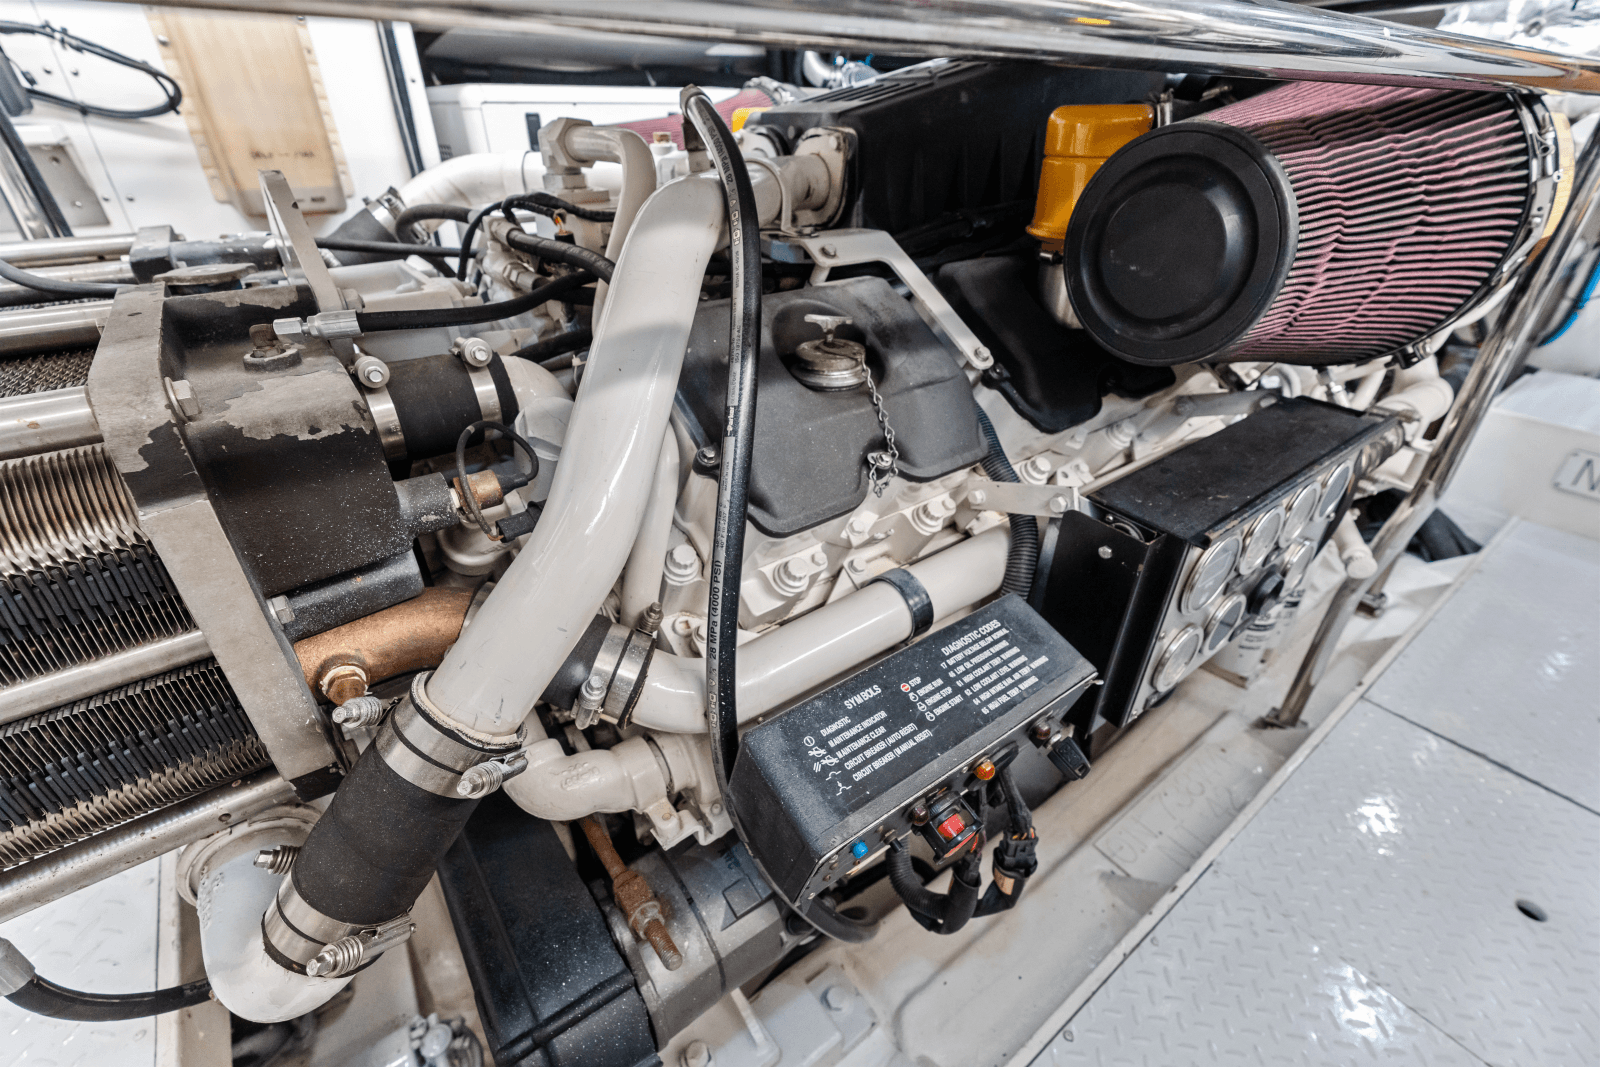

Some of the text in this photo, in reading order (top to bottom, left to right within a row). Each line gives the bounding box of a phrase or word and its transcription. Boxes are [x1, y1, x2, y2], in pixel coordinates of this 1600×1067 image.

[721, 156, 730, 172] MPa
[725, 174, 734, 184] 28
[713, 560, 722, 583] PSI)
[710, 586, 720, 616] (4000
[710, 620, 718, 644] MPa
[941, 620, 1001, 656] DIAGNOSTIC CODES
[946, 652, 965, 666] BATTERY
[963, 643, 981, 656] VOLTAGE
[979, 636, 994, 647] BELOW
[991, 628, 1009, 640] NORMAL
[710, 646, 717, 660] 28
[954, 664, 966, 675] LOW
[970, 650, 992, 665] PRESSURE
[989, 640, 1009, 654] WARNING
[962, 673, 976, 683] HIGH
[972, 662, 993, 677] COOLANT
[1000, 646, 1020, 660] WARNING
[908, 676, 921, 687] STOP
[916, 678, 944, 696] ENGINE RUN
[970, 682, 982, 692] LOW
[980, 671, 1000, 687] COOLANT
[997, 665, 1012, 676] LEVEL
[1007, 655, 1028, 669] WARNING
[972, 698, 981, 706] 64
[979, 690, 992, 702] HIGH
[989, 682, 1006, 696] INTAKE
[1029, 655, 1049, 669] WARNING
[844, 684, 882, 709] SYMBOLS
[925, 686, 952, 706] ENGINE STOP
[933, 694, 964, 716] ENGINE START
[981, 706, 990, 714] 65
[987, 699, 1001, 710] HIGH
[997, 694, 1011, 704] FUEL
[1018, 676, 1039, 690] WARNING
[820, 716, 851, 737] DIAGNOSTIC
[828, 710, 887, 748] MAINTENANCE INDICATOR
[836, 726, 886, 759] MAINTENANCE CLEAR
[844, 723, 918, 770] CIRCUIT BREAKER (AUTO RESET)
[852, 729, 933, 782] CIRCUIT BREAKER (MANUAL RESET)
